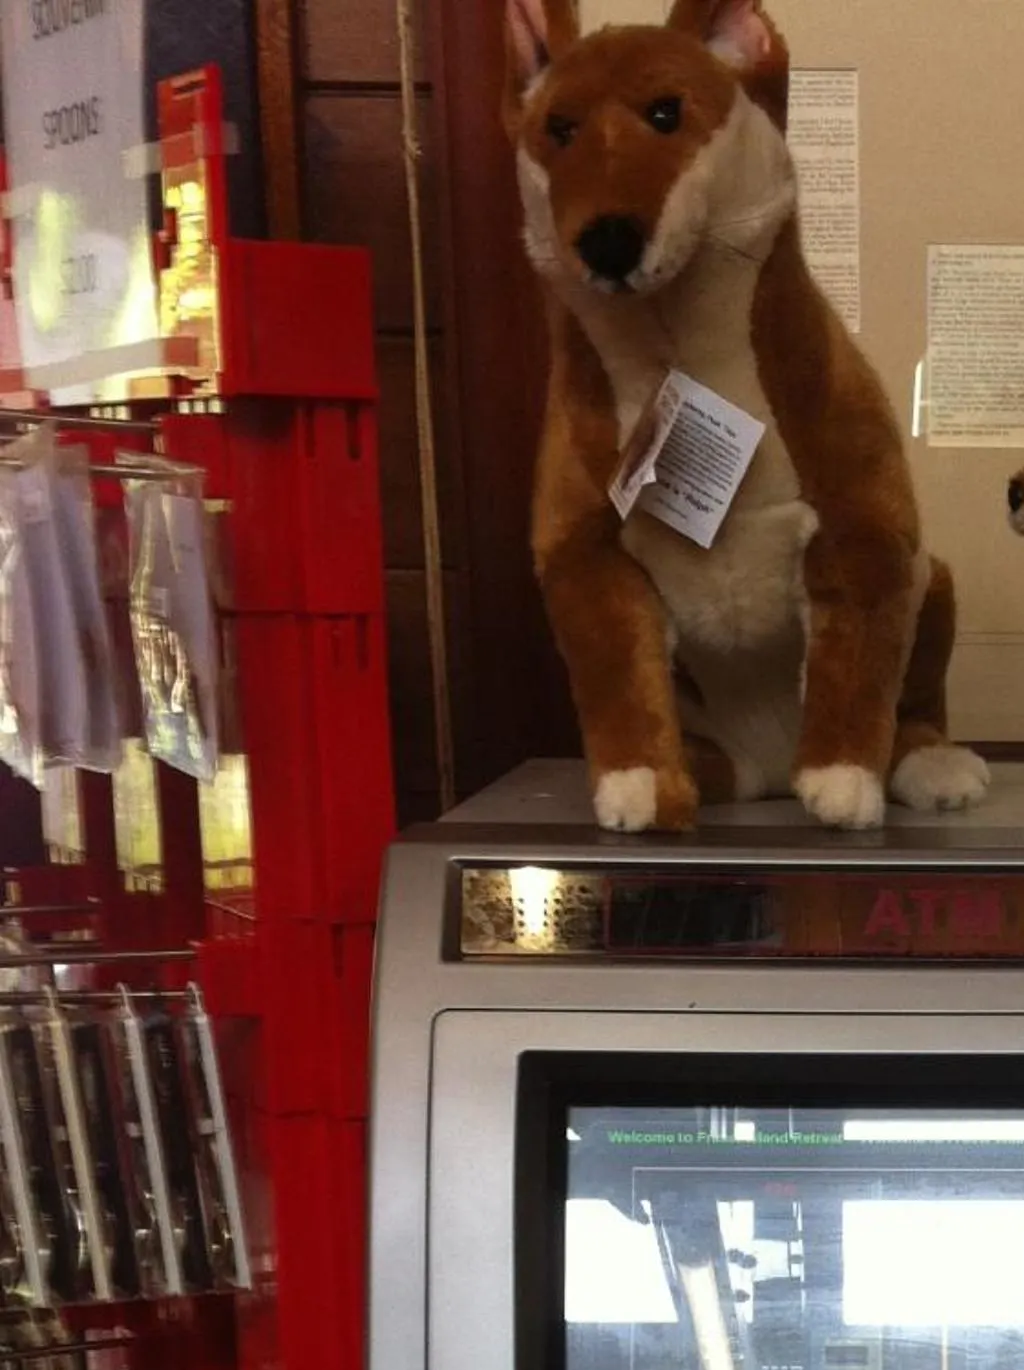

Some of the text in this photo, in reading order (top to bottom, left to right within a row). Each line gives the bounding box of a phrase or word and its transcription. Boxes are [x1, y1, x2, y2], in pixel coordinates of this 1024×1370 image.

[44, 96, 99, 149] SPOONS
[863, 889, 1002, 936] ATM
[608, 1130, 675, 1144] Welcome
[678, 1130, 693, 1144] to
